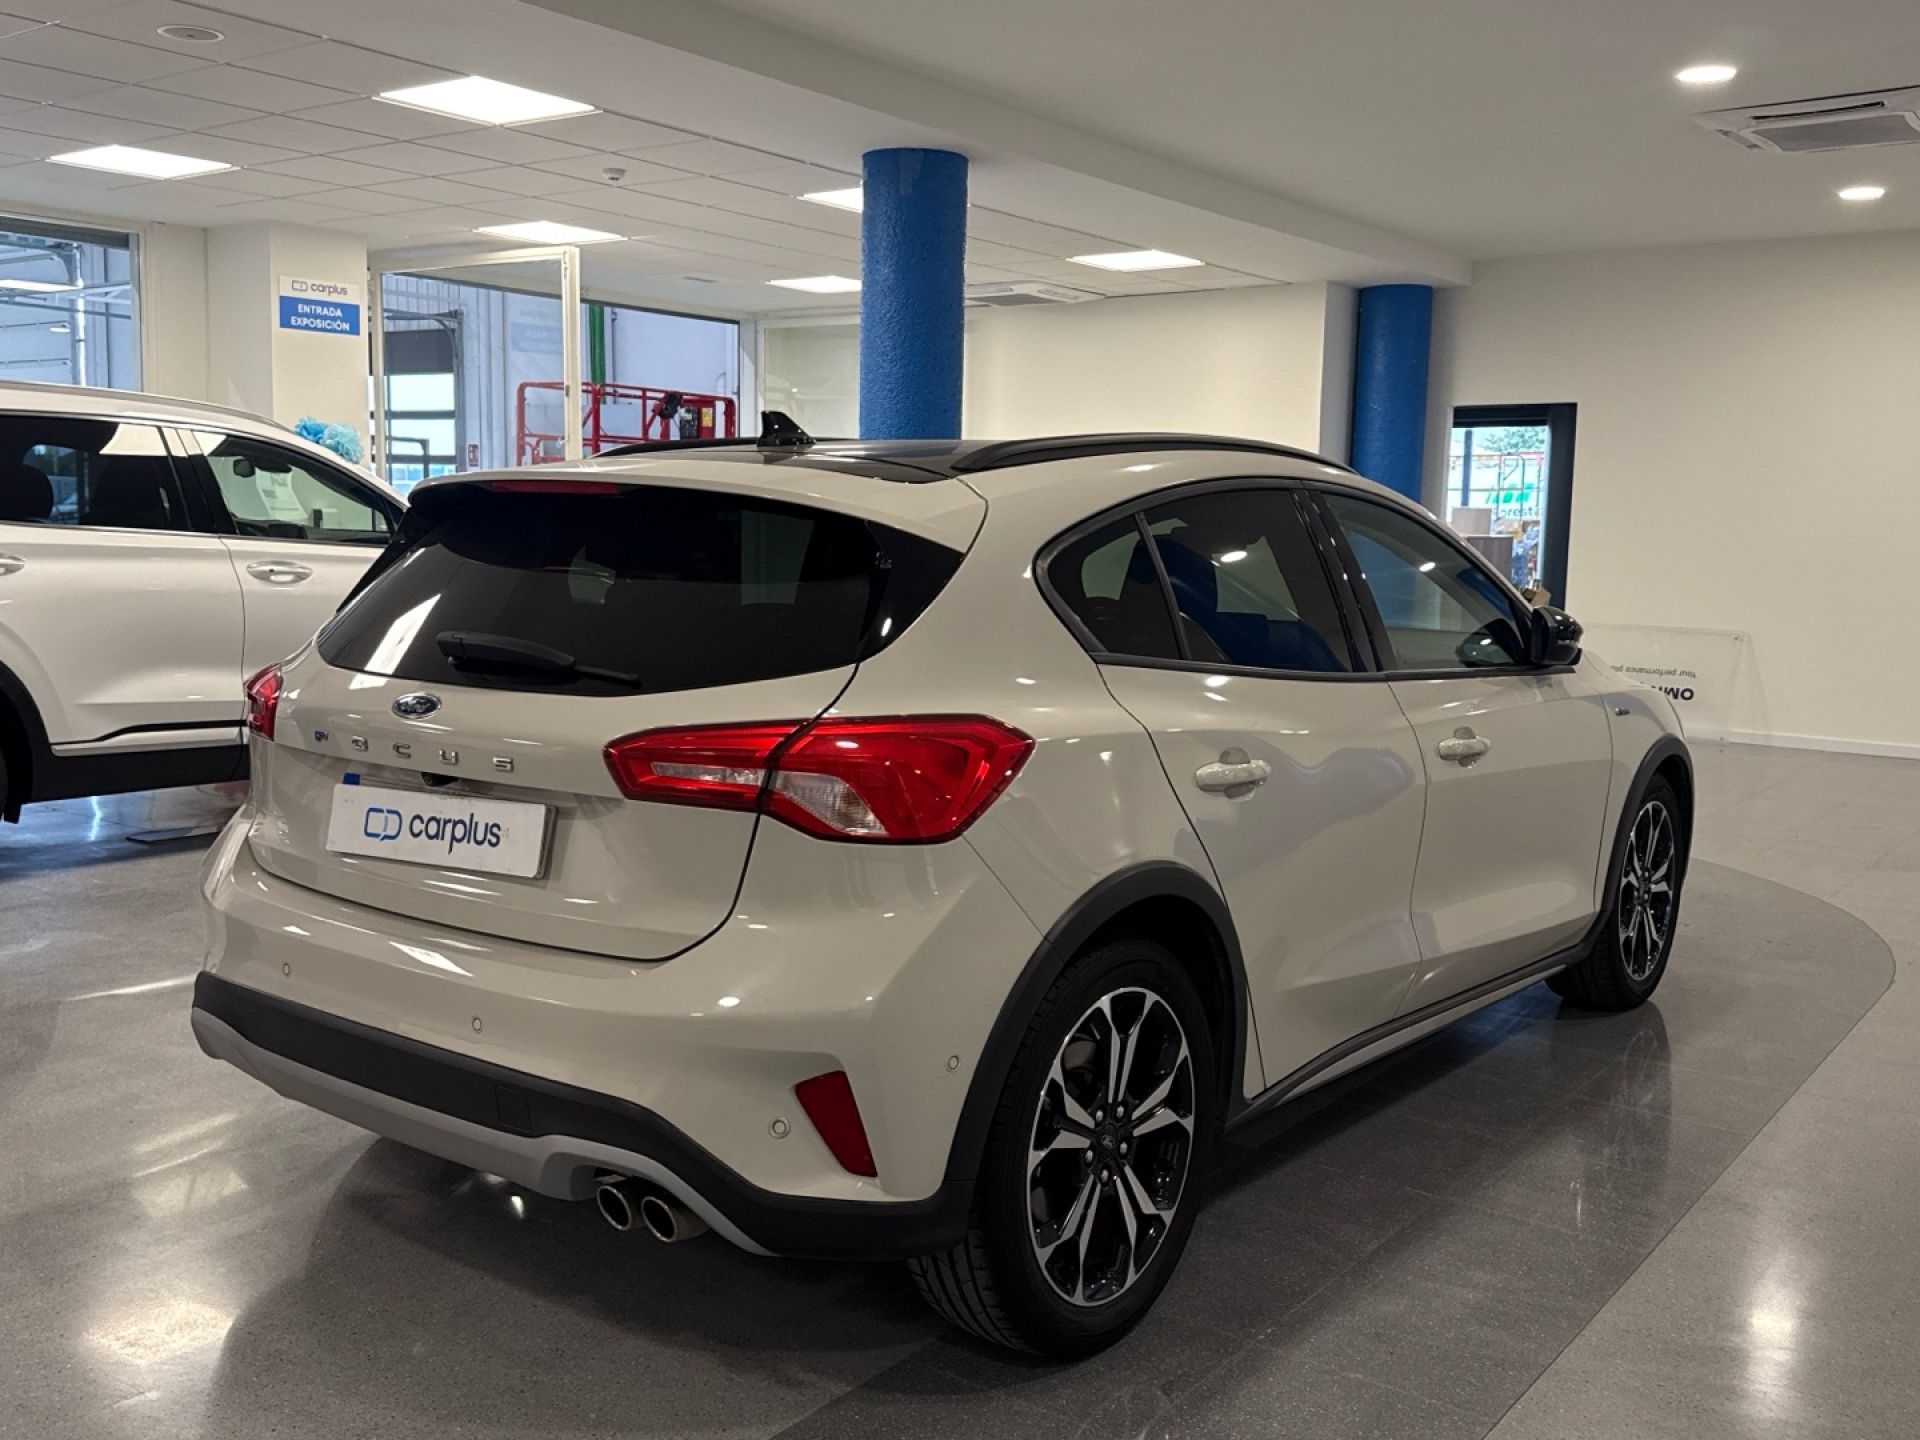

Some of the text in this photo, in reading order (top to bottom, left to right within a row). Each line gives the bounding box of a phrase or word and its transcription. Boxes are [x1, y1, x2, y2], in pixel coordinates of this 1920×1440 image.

[310, 283, 348, 296] carplus
[298, 303, 342, 317] ENTRADA
[291, 316, 350, 331] EXPOSICIÓN
[1625, 666, 1677, 677] performance
[408, 812, 502, 855] carplus
